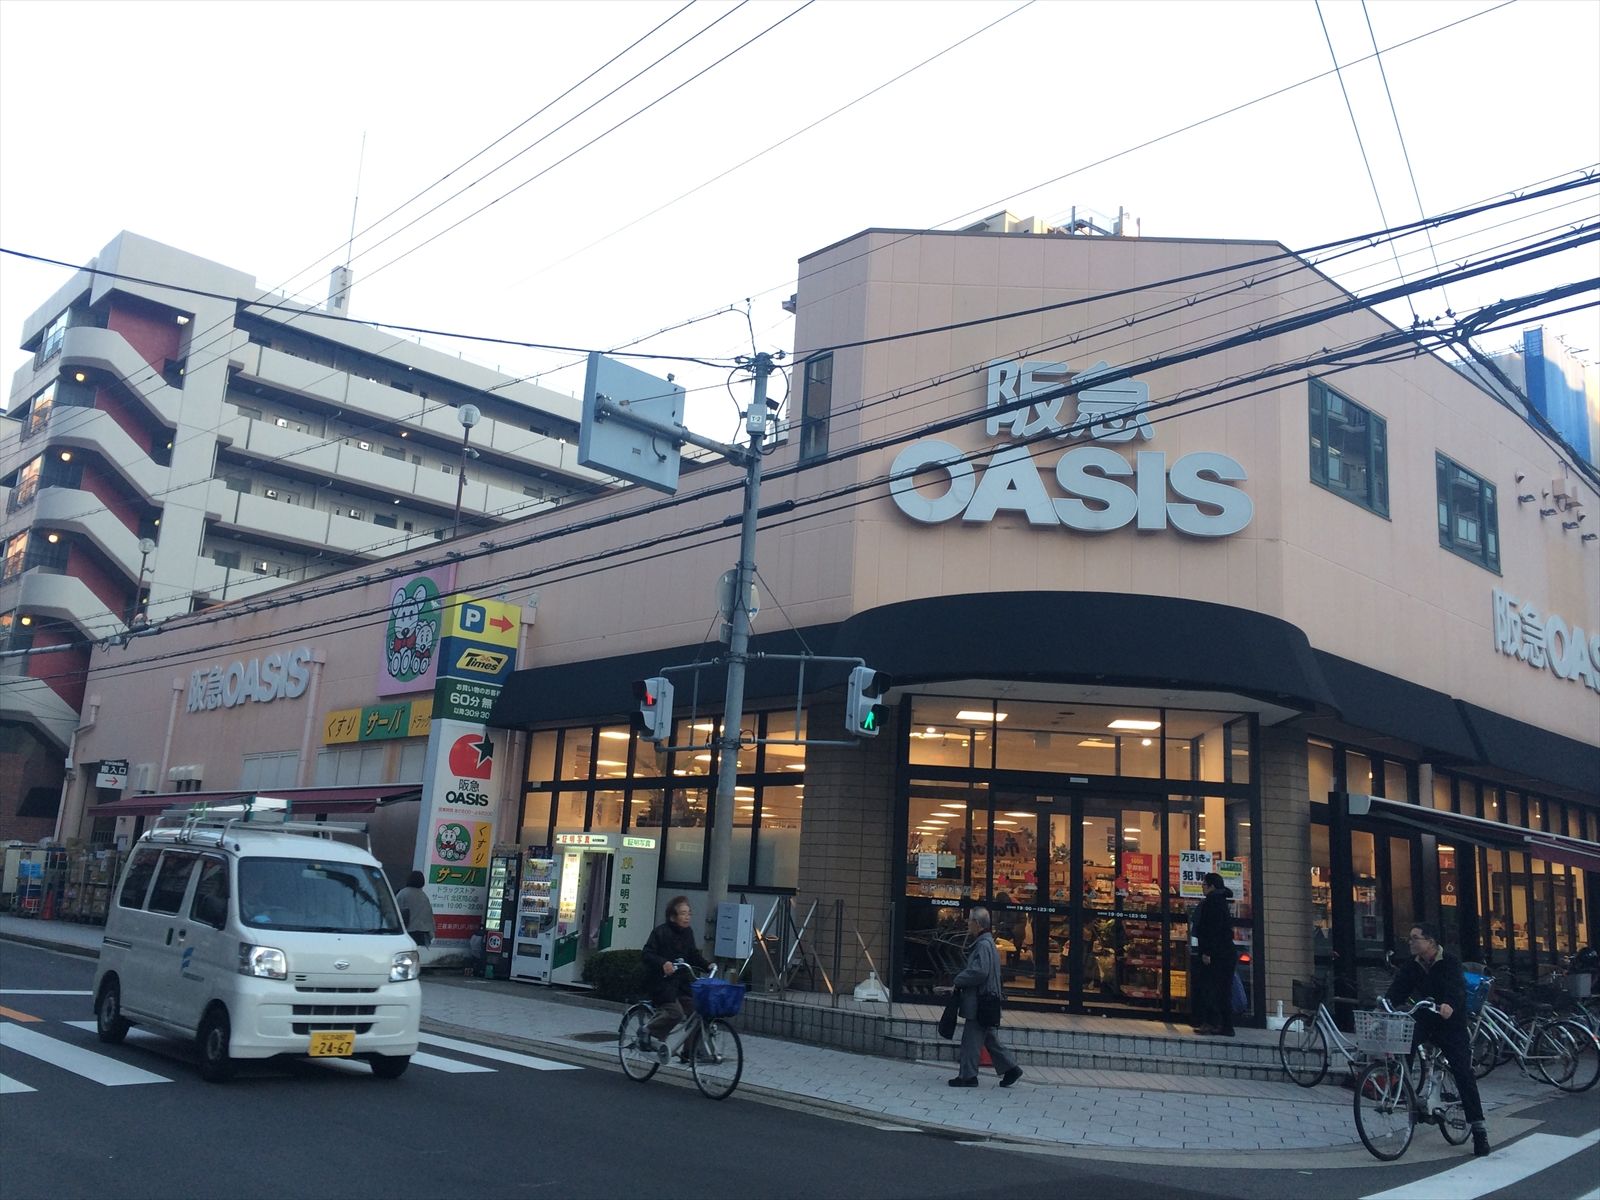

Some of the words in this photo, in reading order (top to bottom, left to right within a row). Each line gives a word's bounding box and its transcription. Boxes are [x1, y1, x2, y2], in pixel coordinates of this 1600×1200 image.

[985, 360, 1156, 442] 阪急
[889, 439, 1254, 537] OASIS
[465, 608, 480, 627] P
[465, 652, 503, 671] Times
[328, 718, 357, 737] くすり
[366, 708, 405, 736] サーバ
[459, 779, 479, 792] 阪急
[446, 791, 488, 806] OASIS
[476, 826, 487, 864] くすり
[437, 867, 476, 883] サーバ
[618, 873, 632, 934] 証明写真
[319, 1042, 352, 1054] 24-67
